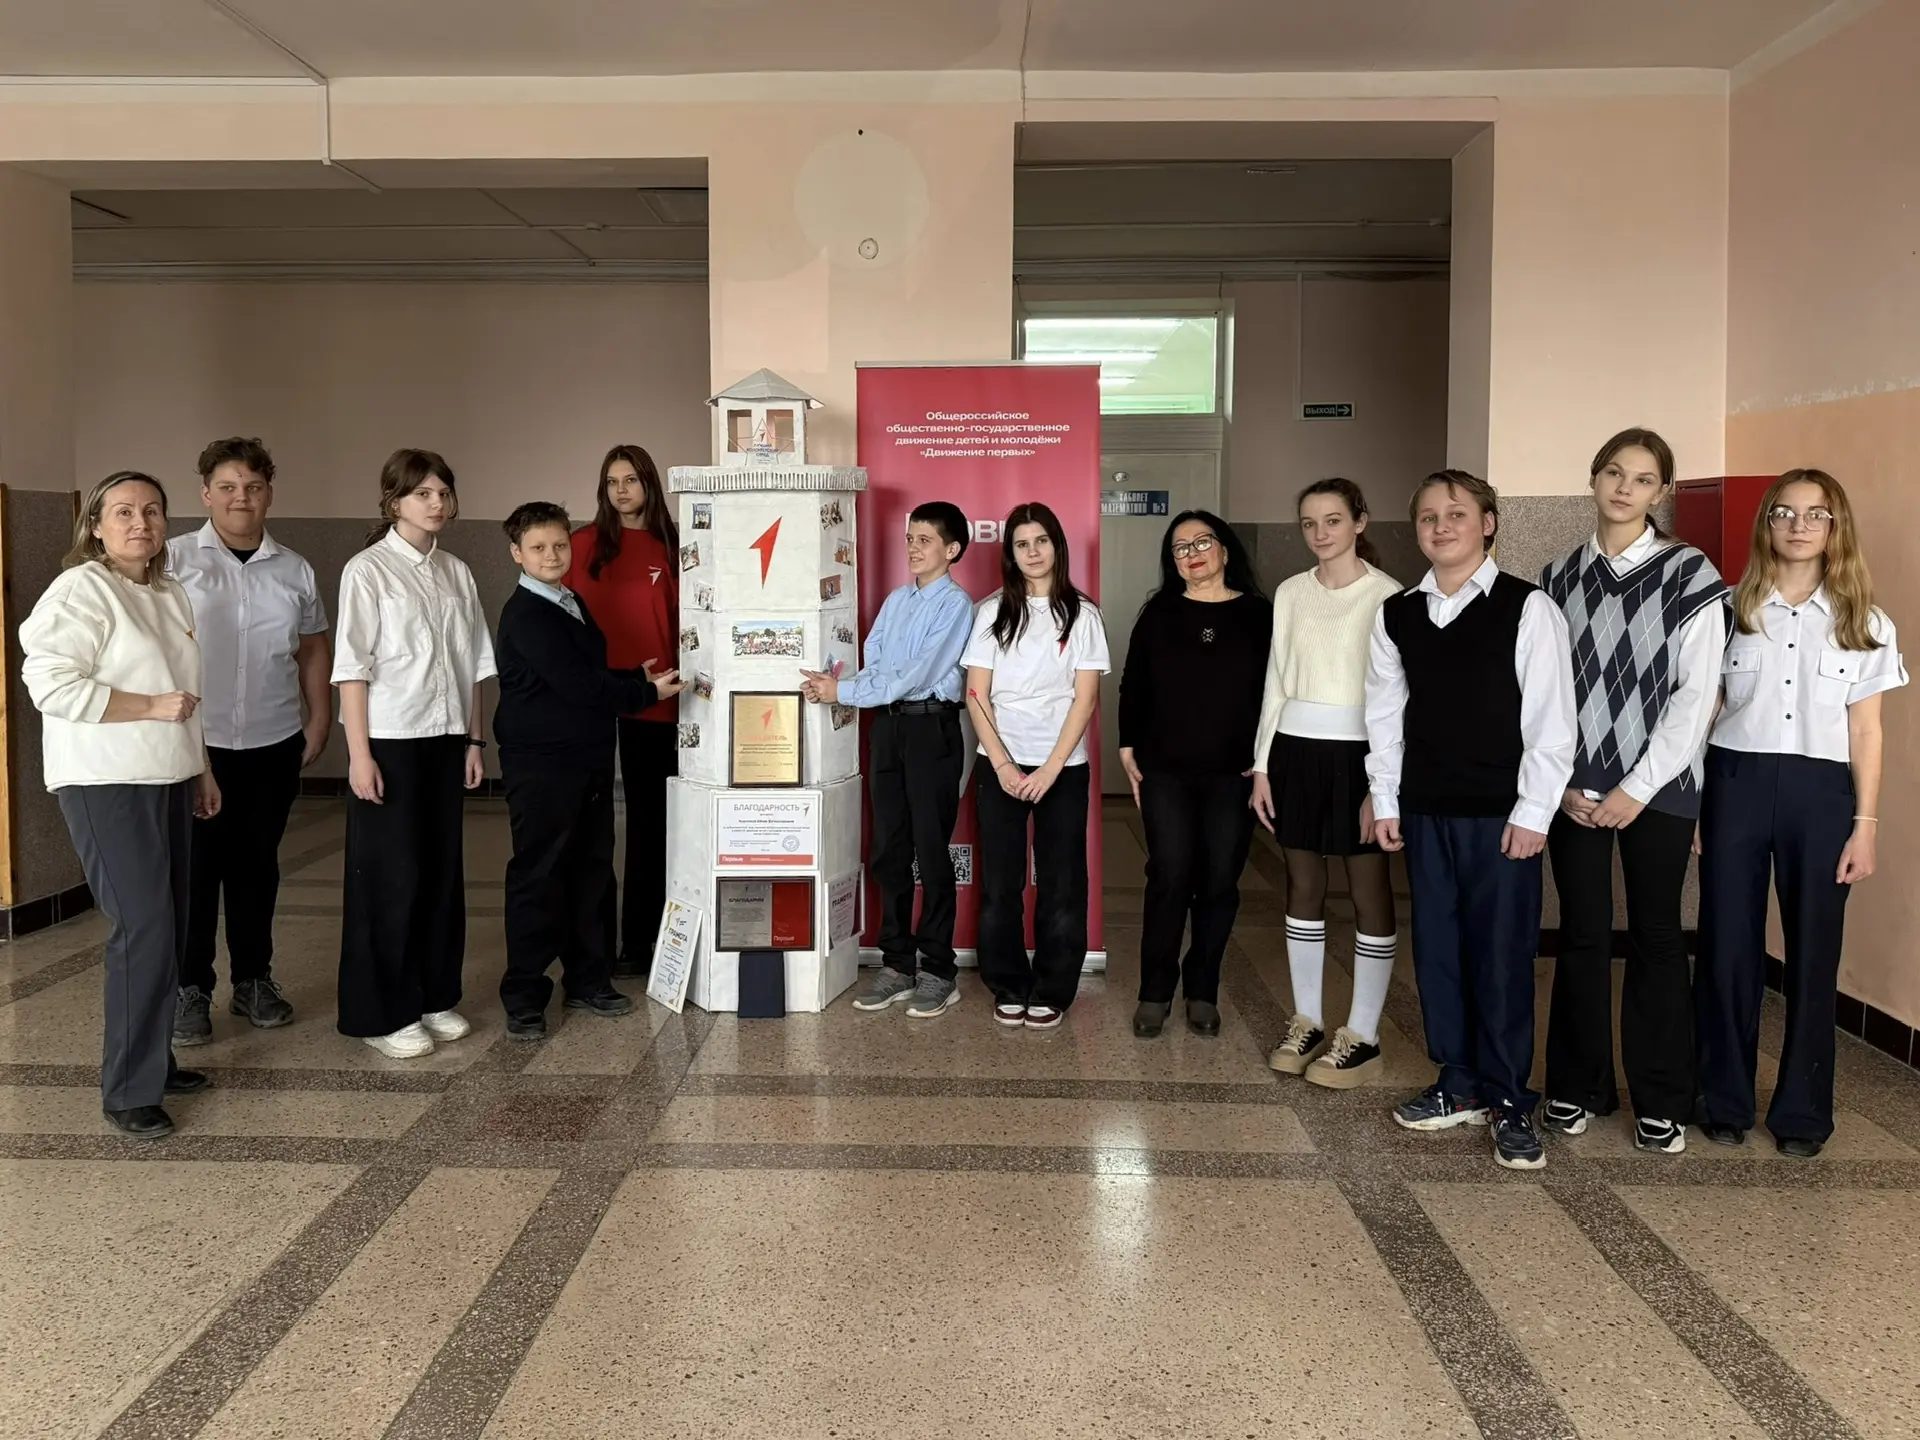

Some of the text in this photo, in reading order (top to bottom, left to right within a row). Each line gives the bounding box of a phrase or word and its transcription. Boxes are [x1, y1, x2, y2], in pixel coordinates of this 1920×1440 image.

[1305, 406, 1336, 415] ВЫХОД
[926, 411, 1030, 422] Общероссийское
[886, 423, 1071, 434] общественно-государственное
[895, 435, 1061, 446] движение детей и молодёжи
[920, 448, 1036, 458] «Движение первых»
[733, 803, 800, 812] БЛАГОДАРНОСТЬ
[668, 927, 688, 943] ГРАМОТА
